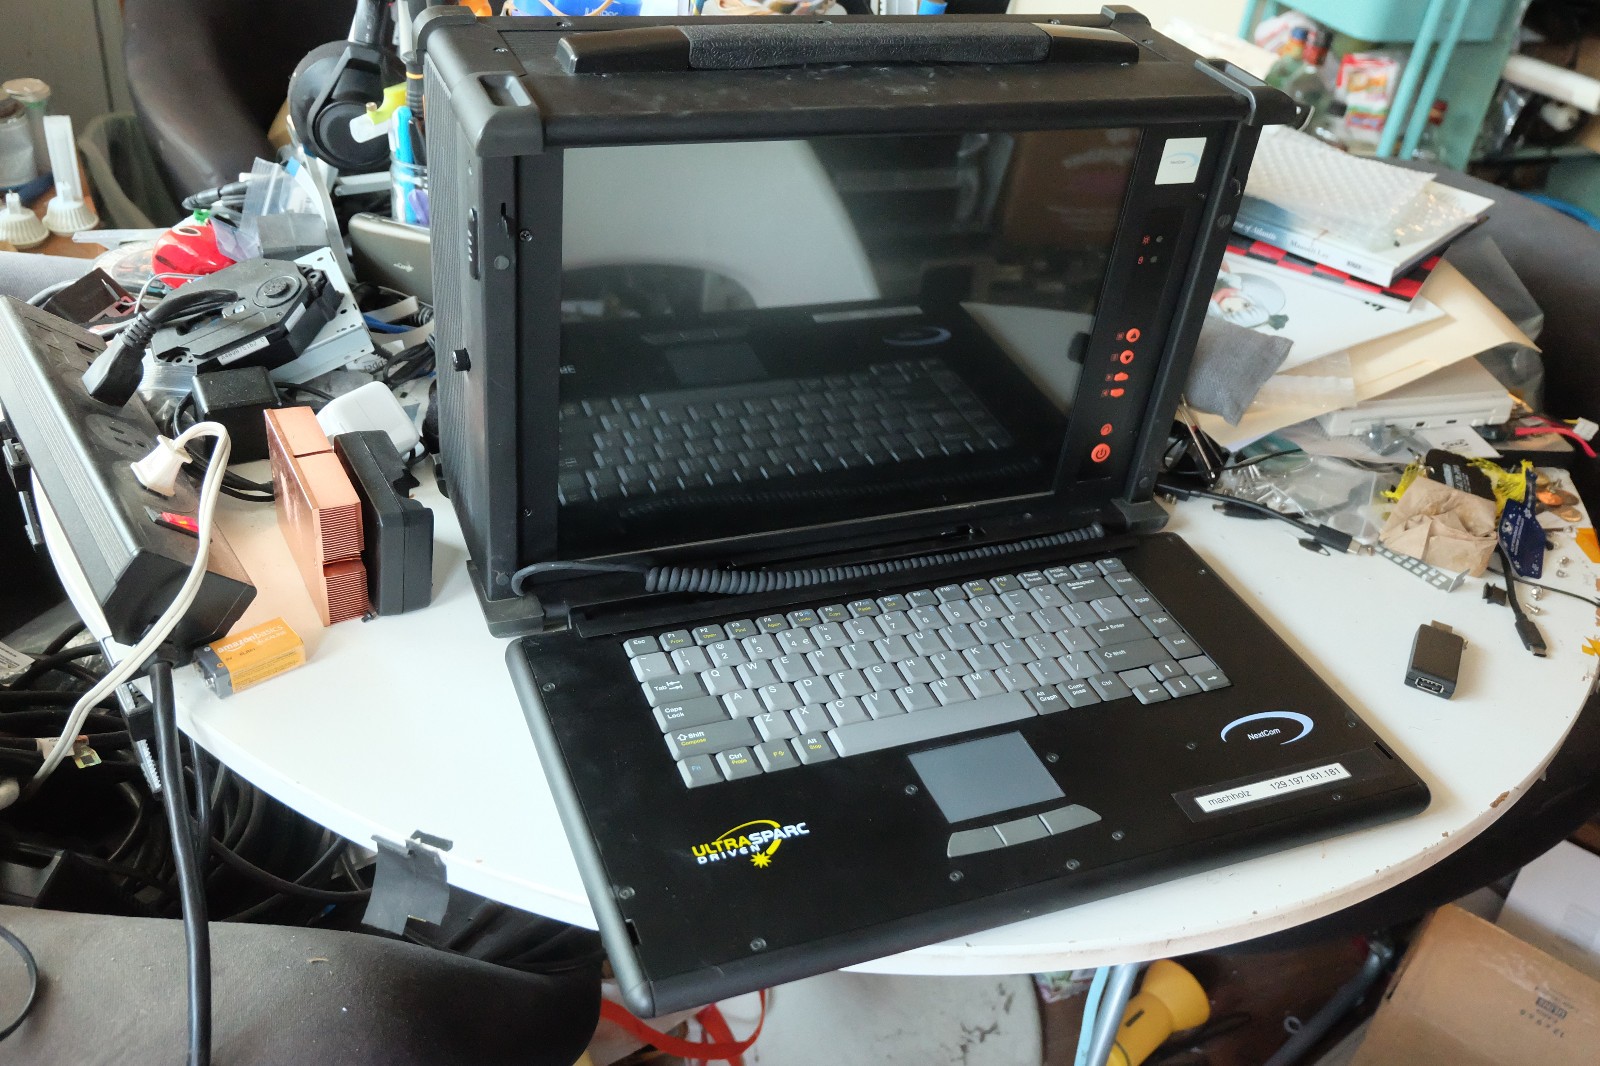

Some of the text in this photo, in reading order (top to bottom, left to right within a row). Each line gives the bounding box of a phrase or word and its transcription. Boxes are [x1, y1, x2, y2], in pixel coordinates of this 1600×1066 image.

[1008, 614, 1016, 622] P
[217, 623, 284, 654] amazonbasics
[914, 632, 924, 640] U
[814, 650, 825, 658] R
[970, 647, 980, 655] K
[721, 652, 729, 660] 2
[780, 656, 790, 664] E
[746, 662, 758, 670] W
[838, 672, 846, 680] F
[802, 679, 813, 687] D
[938, 680, 948, 688] N
[904, 686, 914, 694] B
[733, 692, 743, 700] A
[835, 700, 845, 708] C
[800, 706, 810, 715] X
[764, 714, 773, 722] Z
[687, 730, 705, 740] Shift
[1247, 728, 1281, 741] NextCom
[680, 737, 708, 747] Compose
[728, 752, 744, 760] Ctrl
[1208, 767, 1341, 806] machholz 129.197.161.181
[692, 822, 811, 858] ULTRASPARC
[696, 844, 762, 866] DRIVEN
